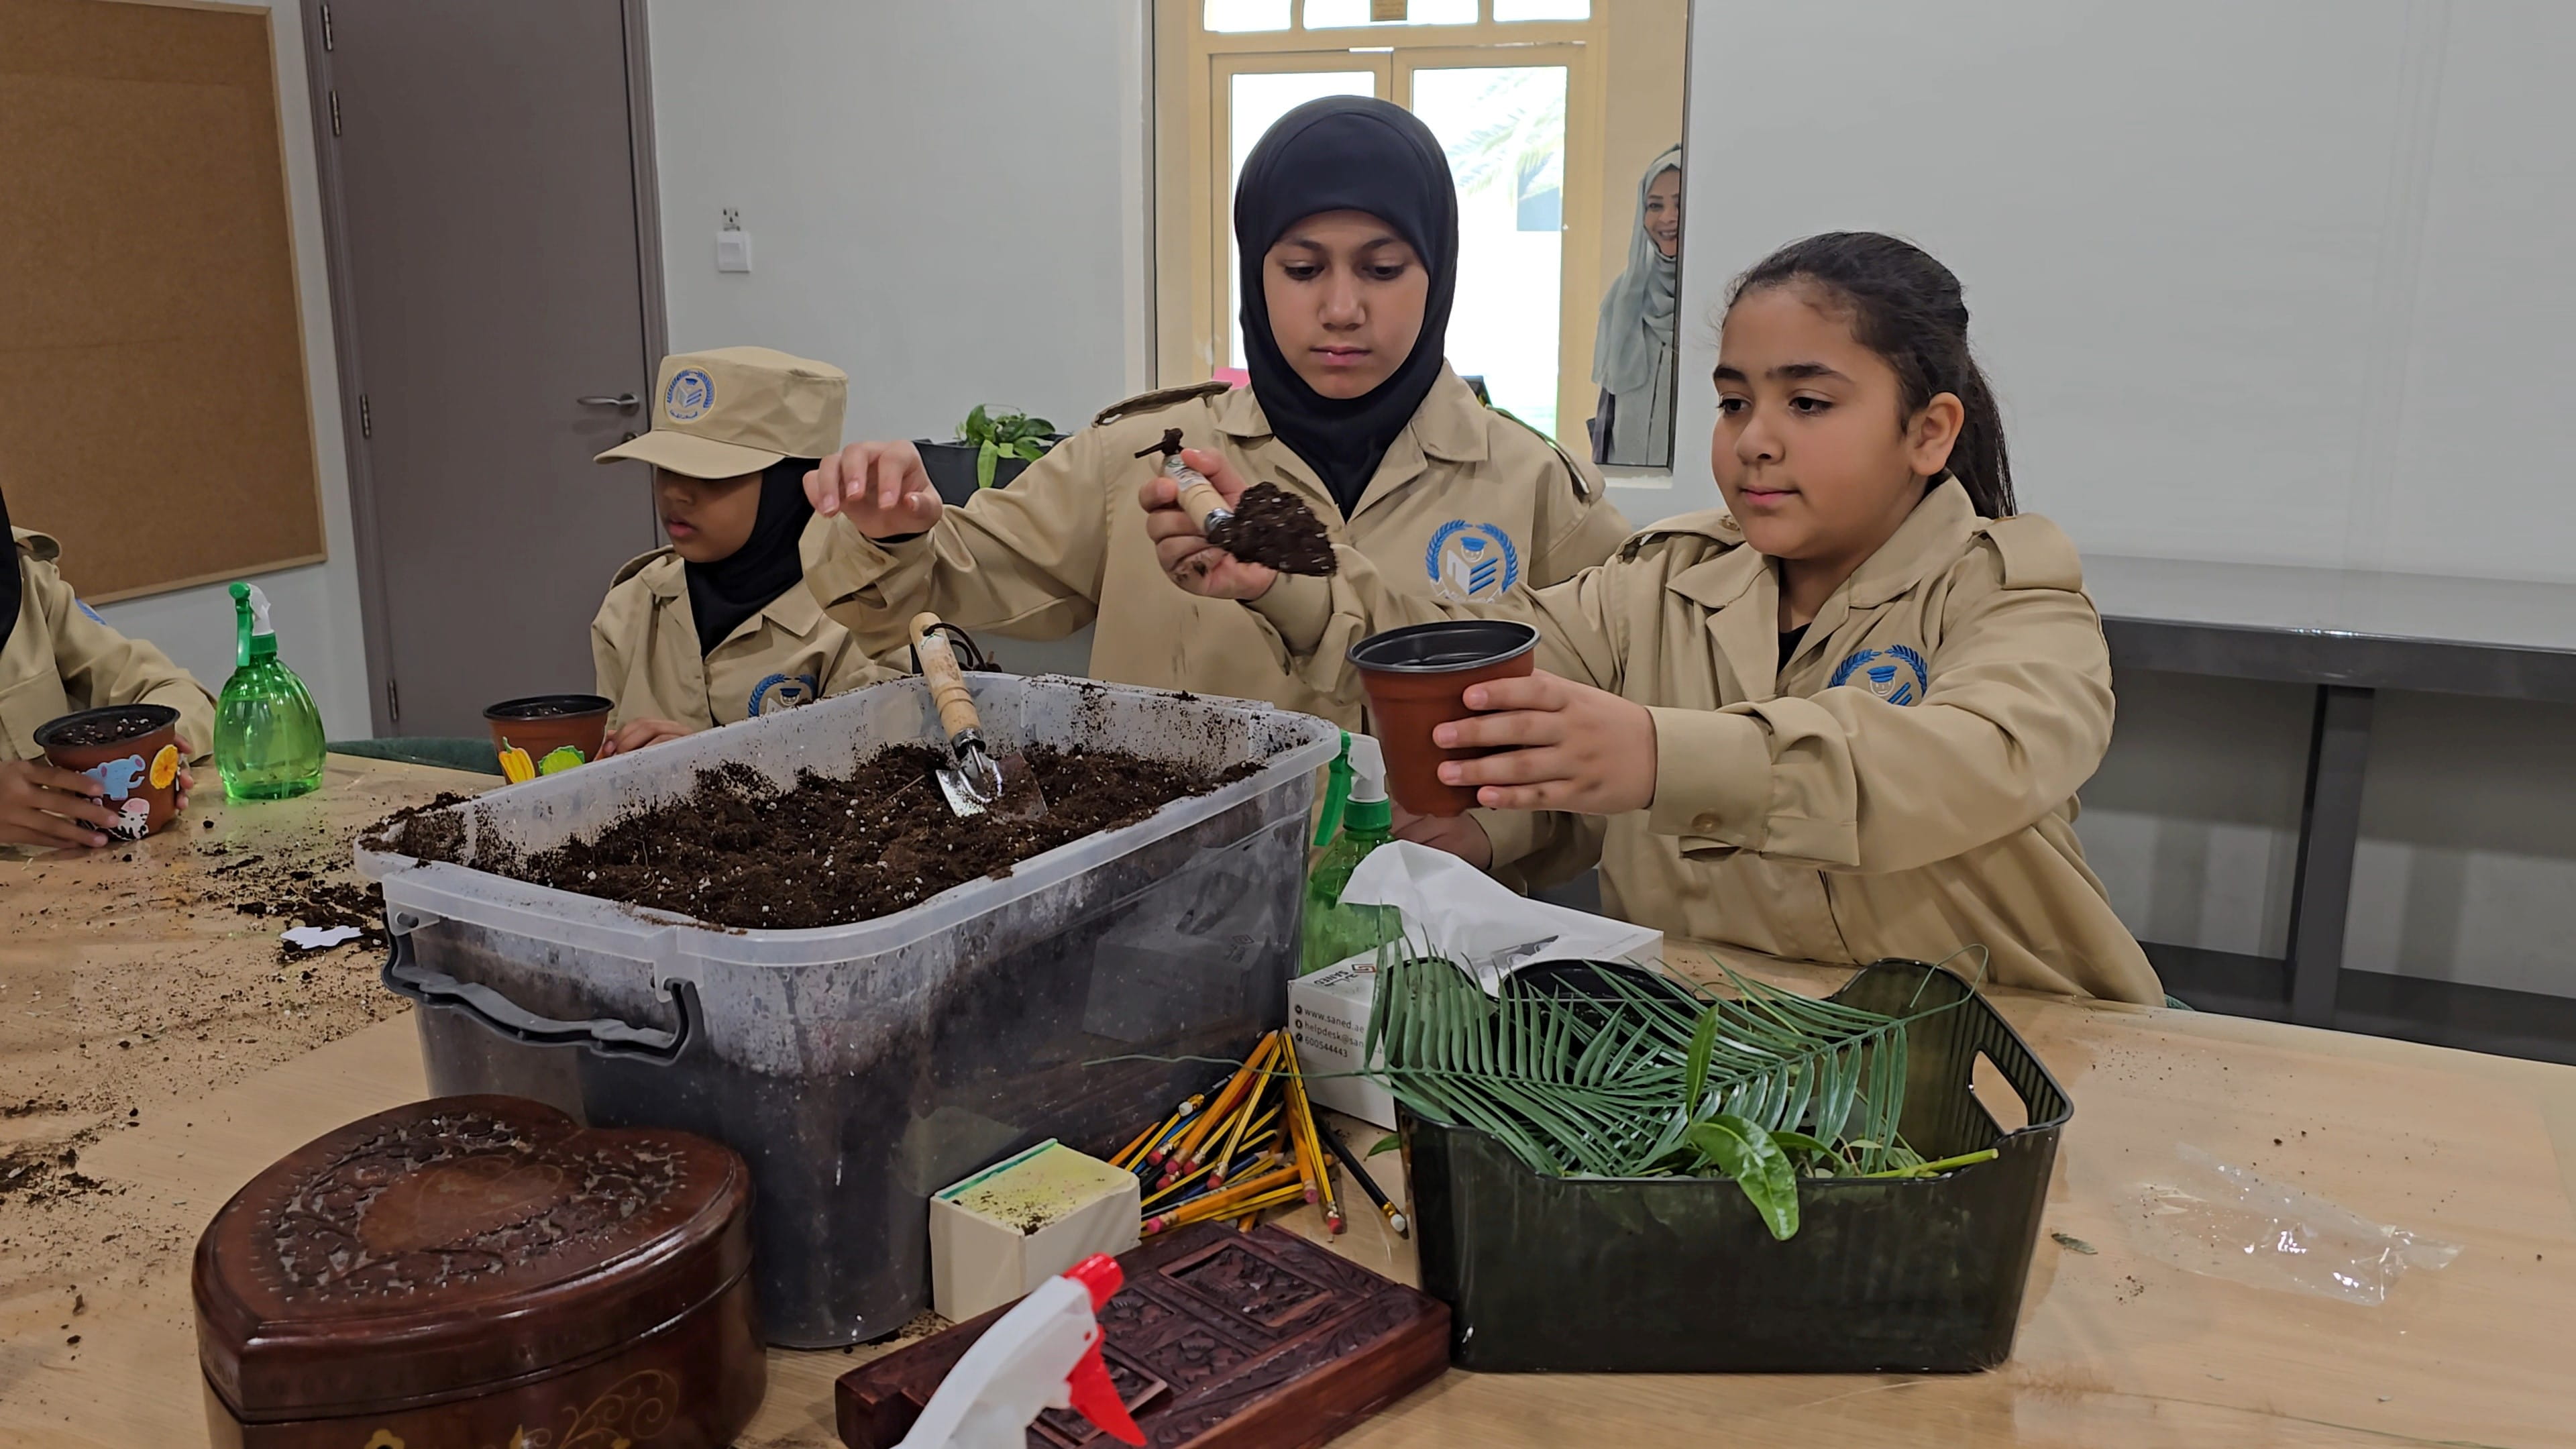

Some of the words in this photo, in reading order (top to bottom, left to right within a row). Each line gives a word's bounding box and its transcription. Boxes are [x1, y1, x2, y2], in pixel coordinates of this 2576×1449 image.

[1313, 970, 1349, 984] SANED
[1304, 1008, 1365, 1034] www.saned.ae
[1305, 1036, 1348, 1058] 600544443
